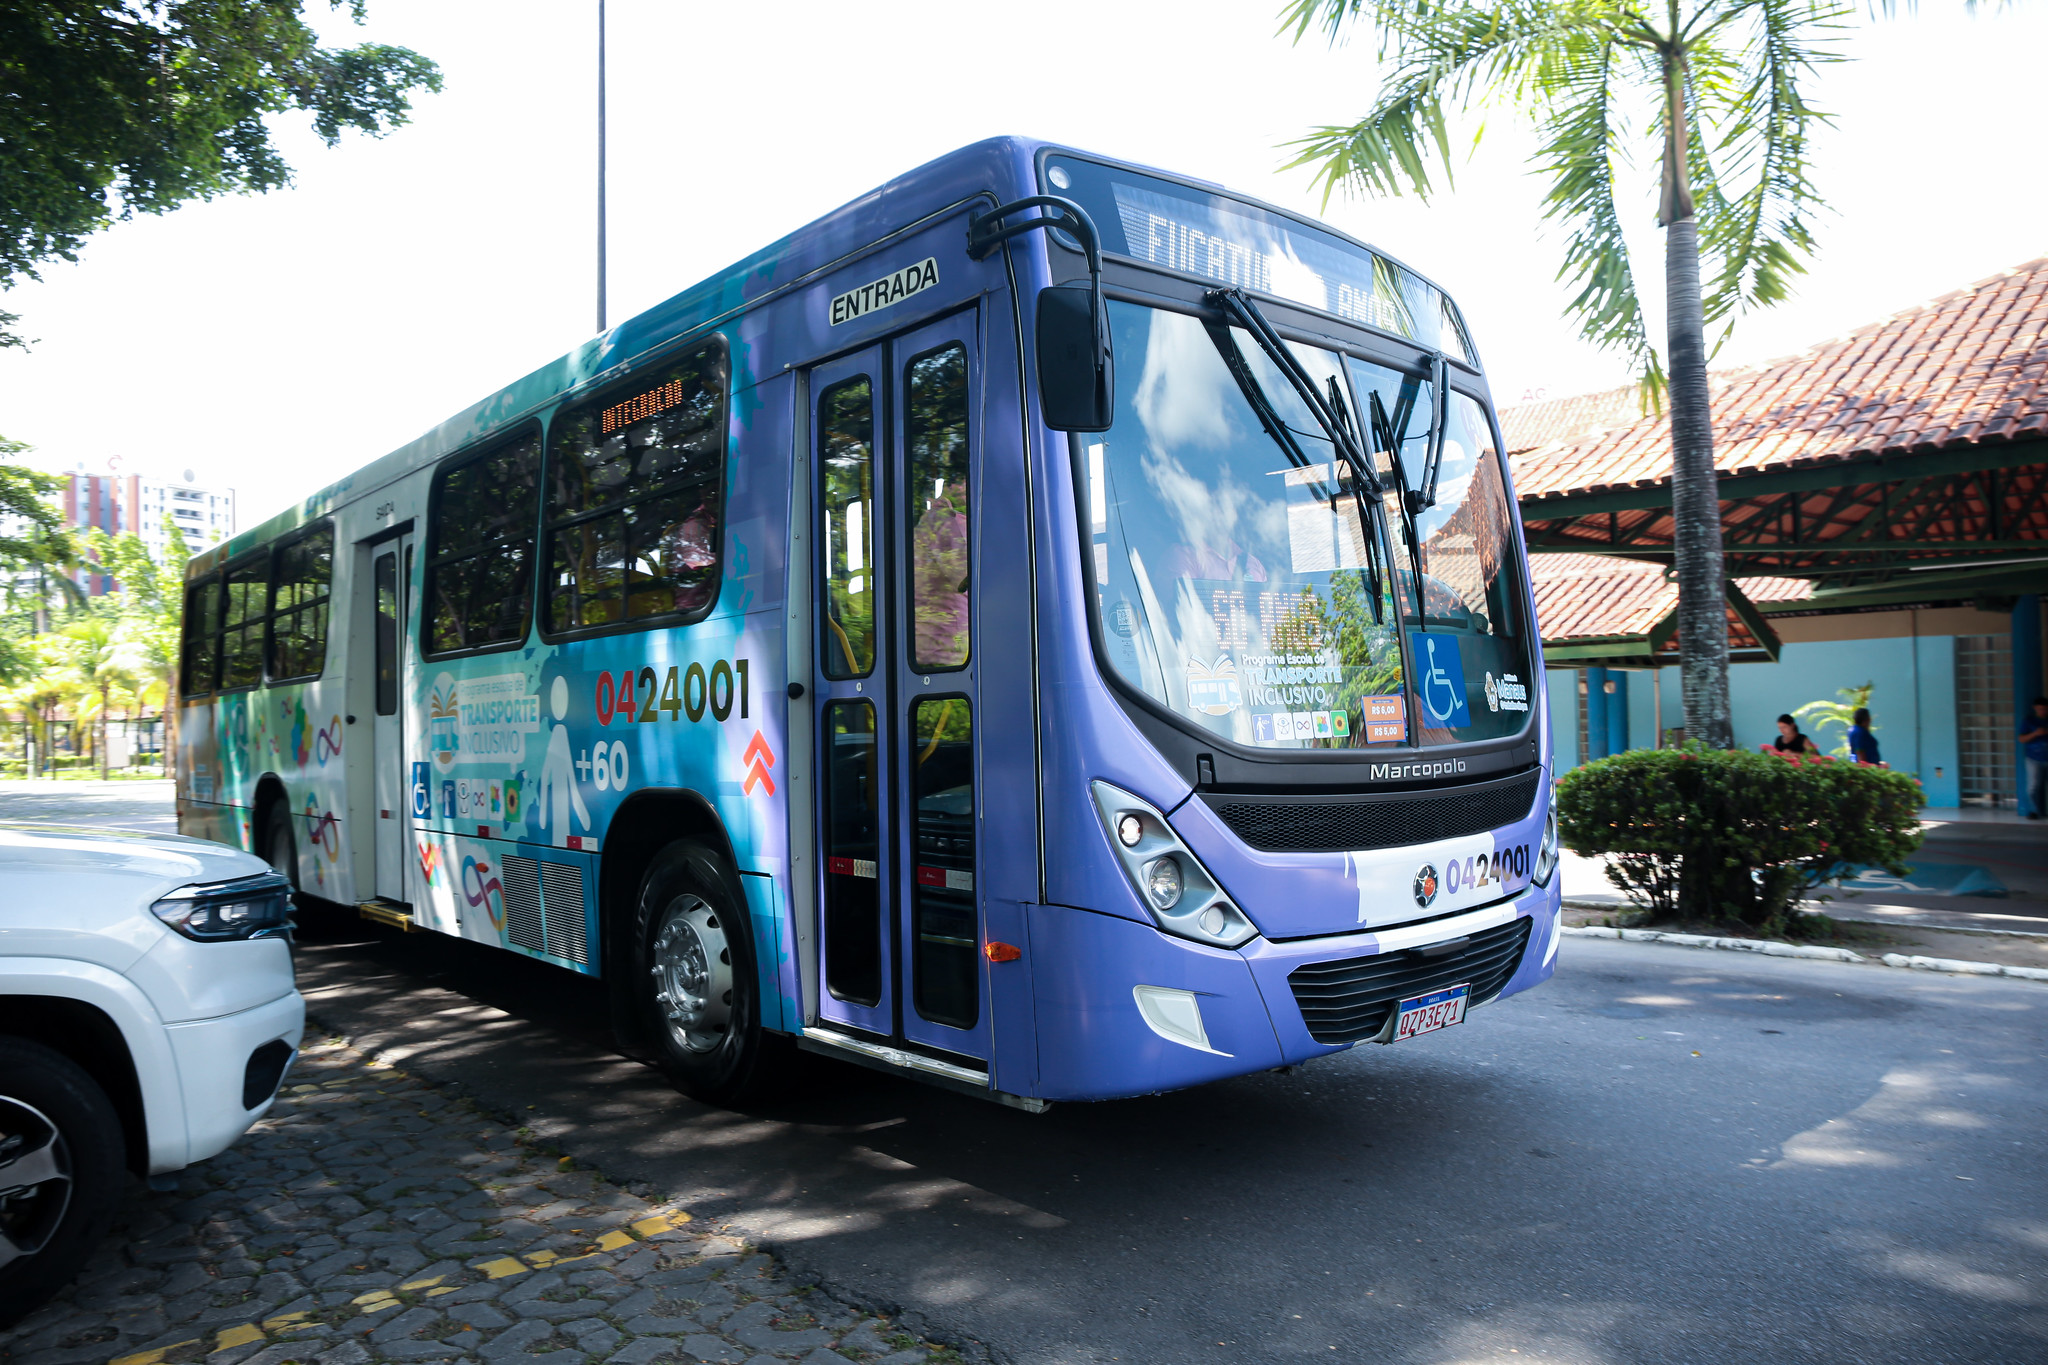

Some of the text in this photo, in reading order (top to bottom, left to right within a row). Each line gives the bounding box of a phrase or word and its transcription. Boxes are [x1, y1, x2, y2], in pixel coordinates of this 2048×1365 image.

[832, 259, 937, 325] ENTRADA
[1213, 589, 1322, 650] 60 ANOS
[1241, 653, 1325, 667] Programa Escola de
[1244, 666, 1343, 686] TRANSPORTE
[595, 659, 749, 727] 0424001
[1248, 685, 1326, 707] INCLUSIVO
[461, 698, 537, 727] TRANSPORTE
[460, 730, 520, 755] INCLUSIVO
[575, 739, 630, 792] +60
[1370, 758, 1466, 780] Marcopolo
[1446, 844, 1530, 894] 0424001
[1400, 1000, 1459, 1036] QZP3E71
